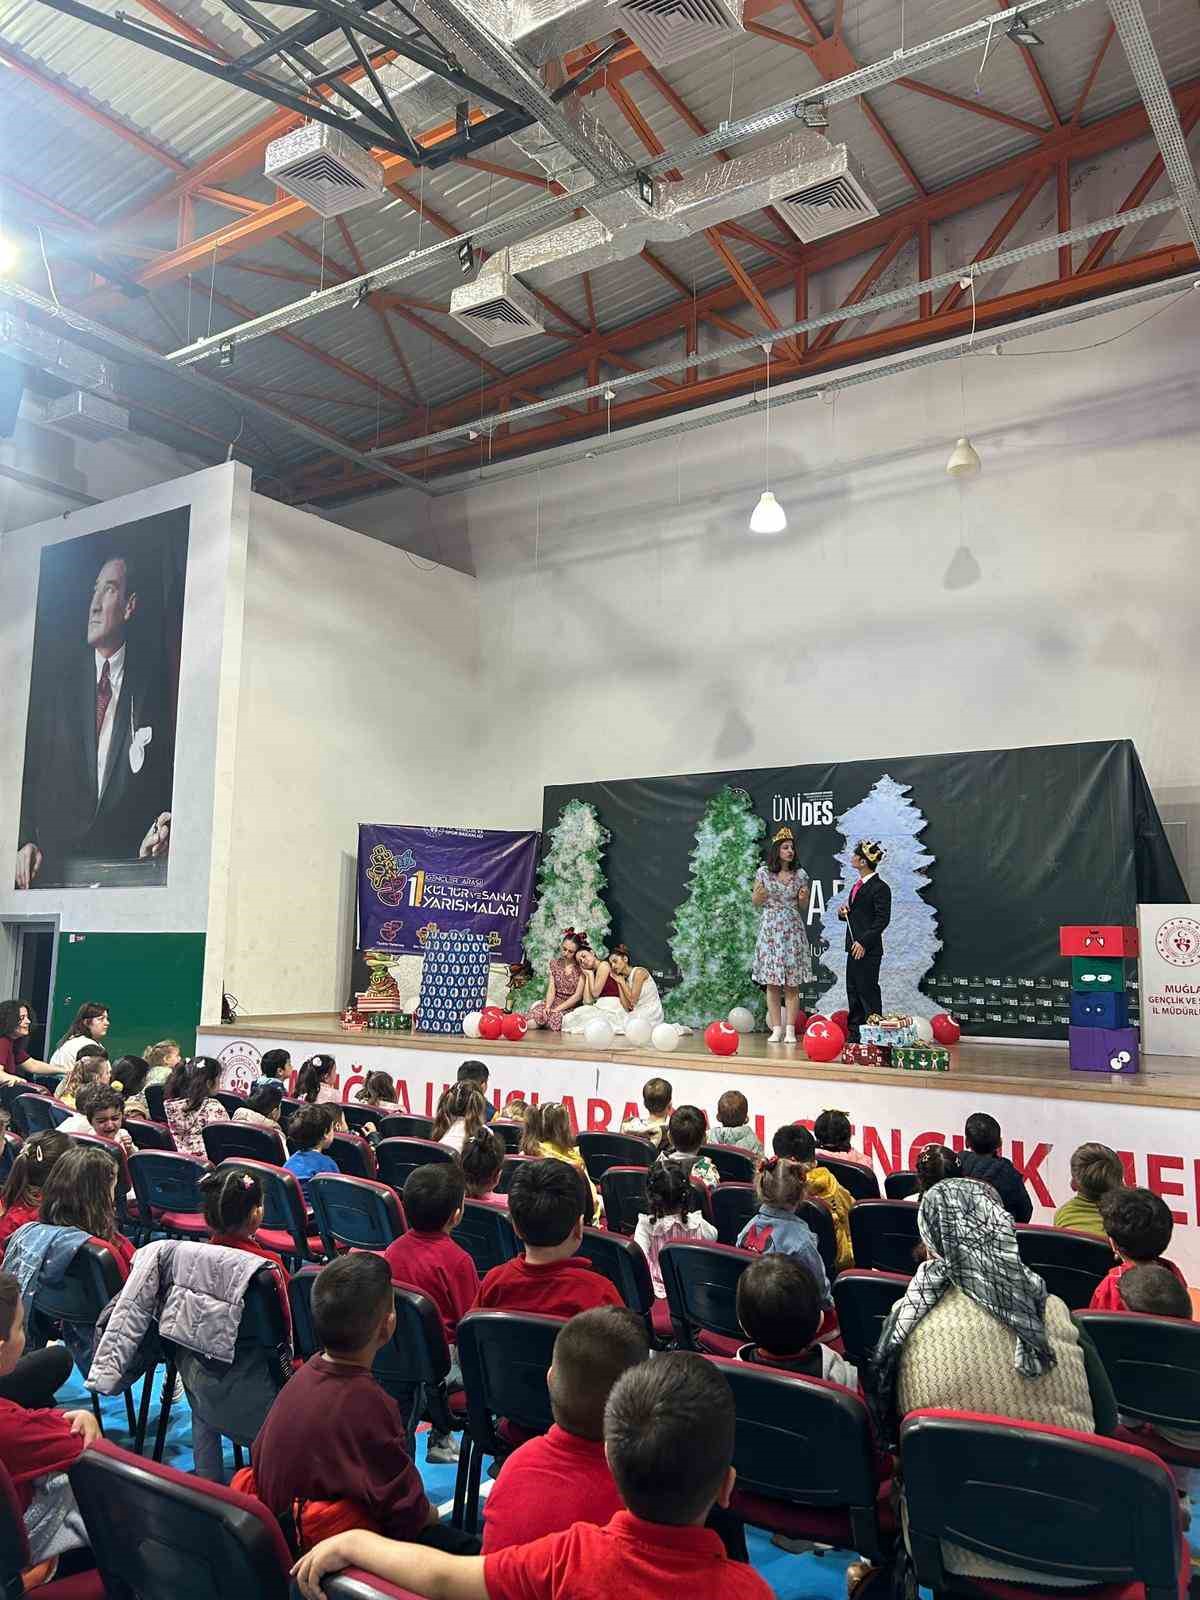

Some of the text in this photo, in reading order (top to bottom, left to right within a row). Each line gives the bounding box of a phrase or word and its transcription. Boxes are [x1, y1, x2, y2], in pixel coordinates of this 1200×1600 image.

[424, 884, 469, 898] KÜLTÜR
[481, 890, 522, 903] SANAT
[1148, 995, 1196, 1005] GENÇLİK VE
